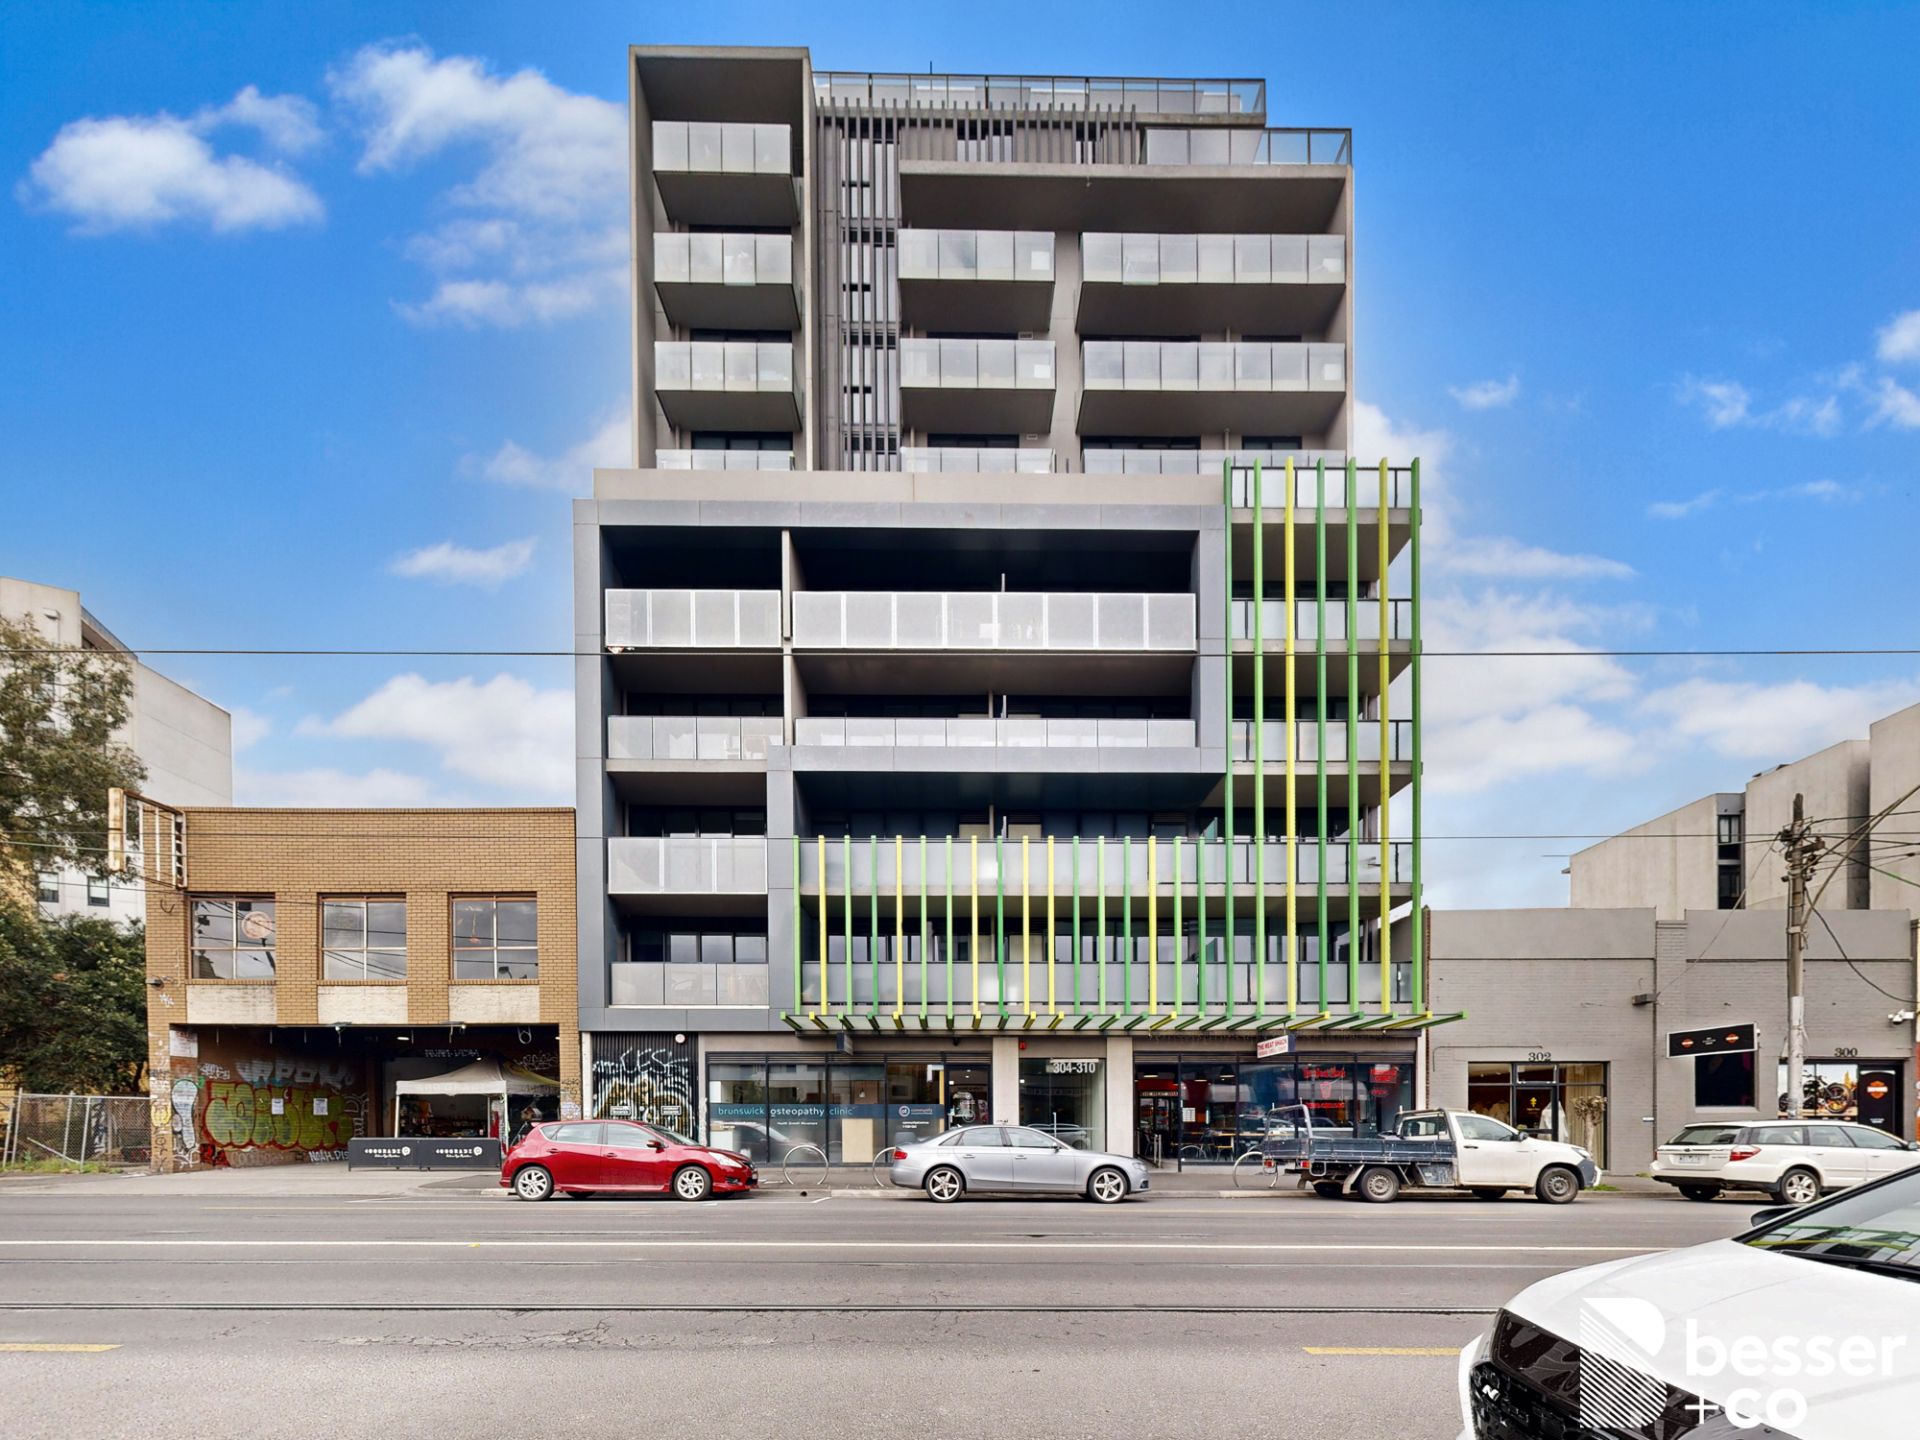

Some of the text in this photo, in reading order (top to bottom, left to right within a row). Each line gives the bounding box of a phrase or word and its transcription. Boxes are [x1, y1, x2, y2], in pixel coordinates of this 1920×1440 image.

[1528, 1052, 1551, 1062] 302
[1834, 1047, 1858, 1057] 300
[1053, 1062, 1096, 1073] 304-310
[718, 1106, 853, 1117] brunswick osteopathy clinic
